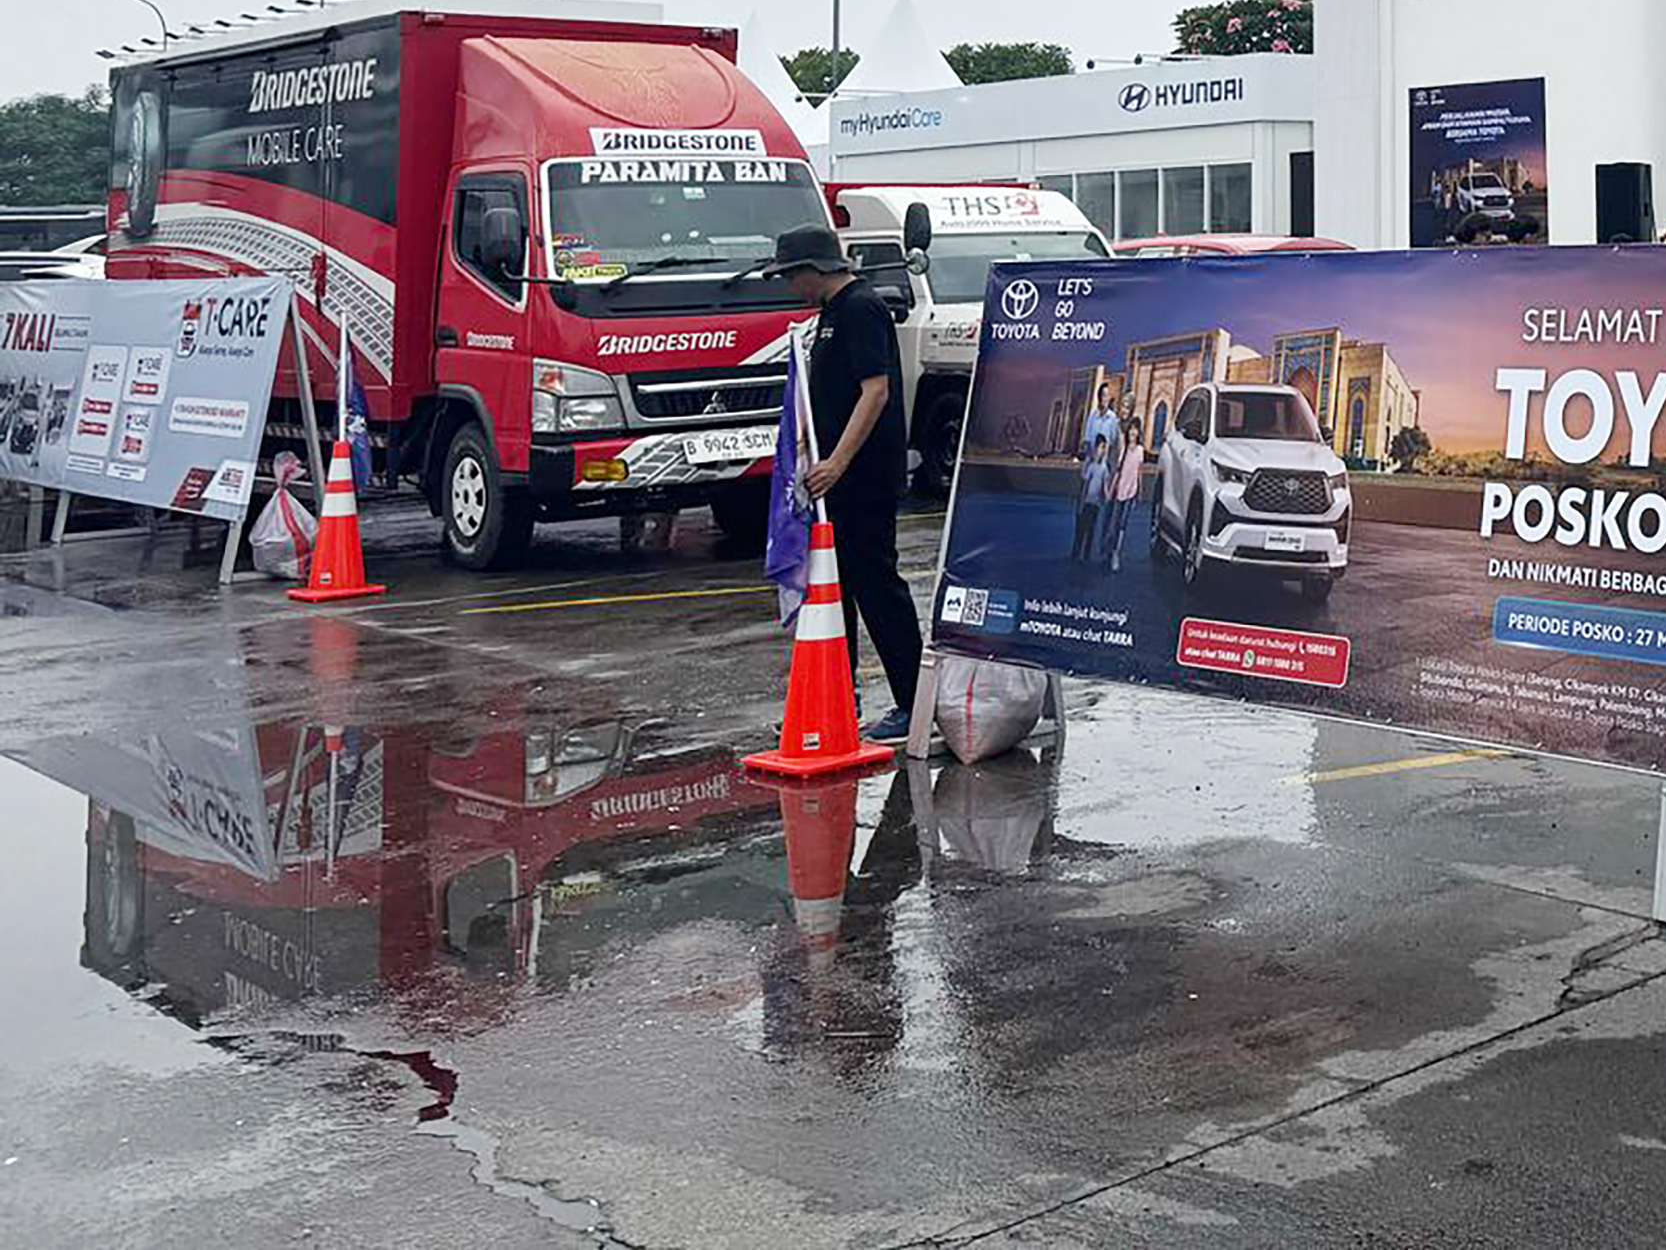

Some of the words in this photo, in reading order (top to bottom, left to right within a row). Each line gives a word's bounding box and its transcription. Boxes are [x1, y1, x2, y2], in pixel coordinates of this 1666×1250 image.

[249, 58, 377, 113] BRIDGESTONE
[1155, 78, 1243, 107] HYUNDAI
[841, 106, 942, 135] myHyundaiCare
[247, 130, 300, 167] MOBILE
[304, 124, 344, 161] CARE
[602, 131, 757, 151] BRIDGESTONE
[581, 161, 724, 183] PARAMITA
[734, 163, 787, 182] BAN
[942, 196, 1001, 215] THS
[1058, 279, 1092, 295] LET'S
[1055, 301, 1073, 318] GO
[991, 324, 1040, 340] TOYOTA
[1052, 323, 1105, 340] BEYOND
[1523, 309, 1662, 344] SELAMAT
[598, 330, 738, 356] BRIDGESTONE
[687, 441, 696, 455] B
[1489, 559, 1524, 579] DAN
[1526, 561, 1598, 588] NIKMATI
[1508, 613, 1569, 637] PERIODE
[1572, 619, 1624, 643] POSKO
[1636, 628, 1653, 646] 27
